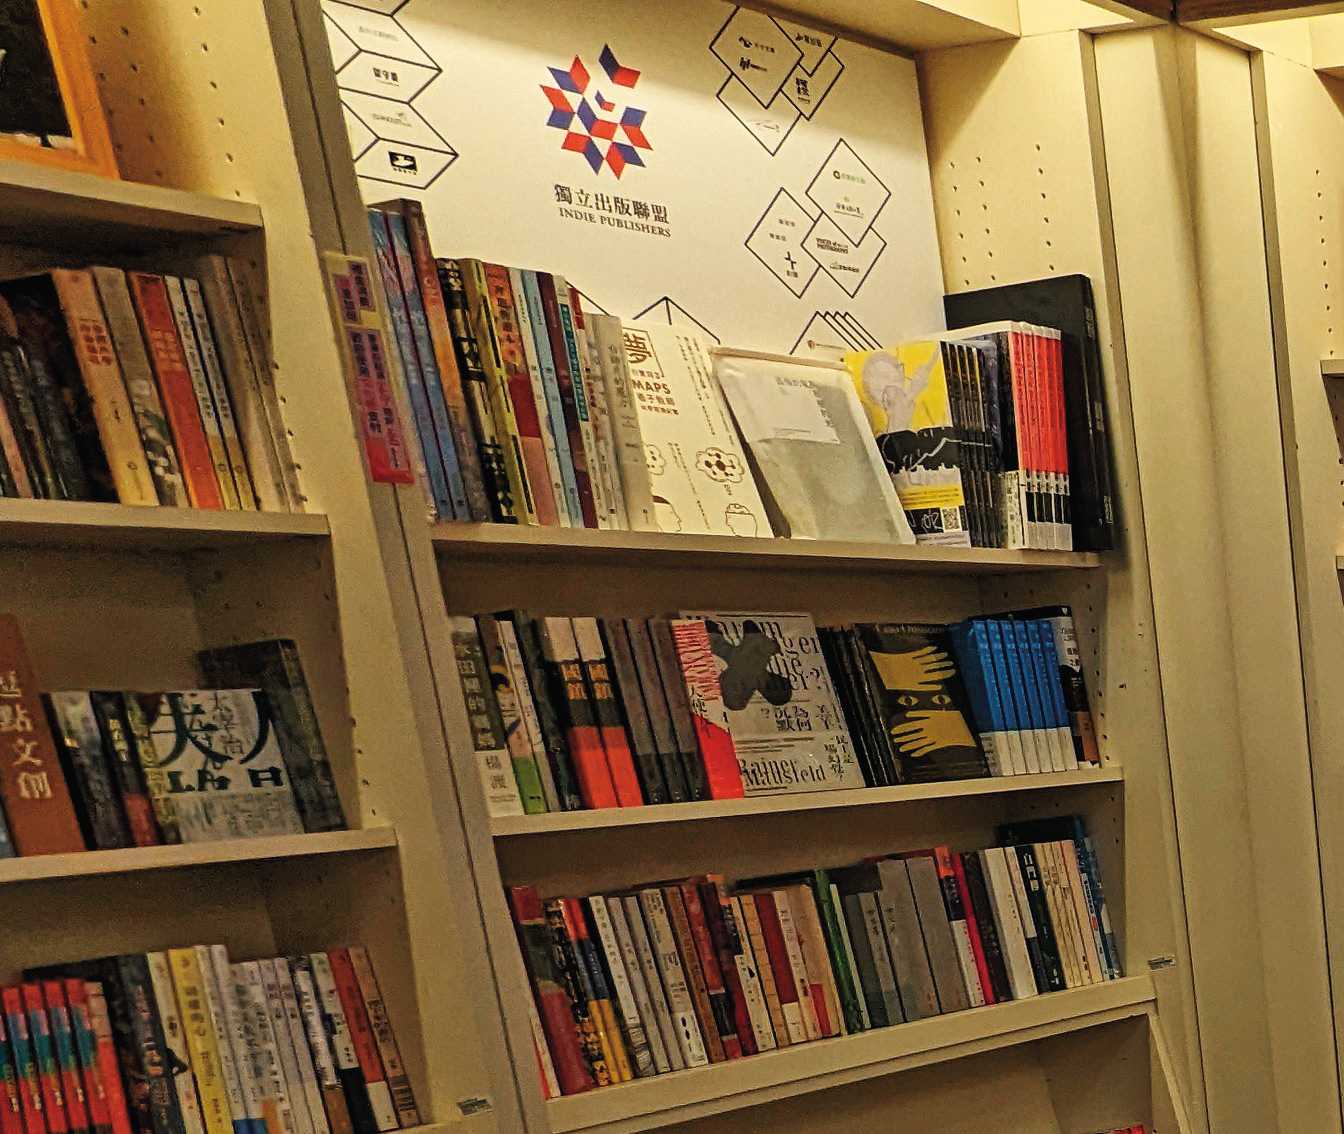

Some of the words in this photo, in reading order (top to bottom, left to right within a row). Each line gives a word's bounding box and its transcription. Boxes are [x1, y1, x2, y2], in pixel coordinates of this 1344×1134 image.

[553, 183, 670, 225] 獨立出版聯盟
[558, 206, 598, 225] INDIE
[599, 214, 672, 238] PUBLISHERS
[631, 378, 671, 395] MAPS
